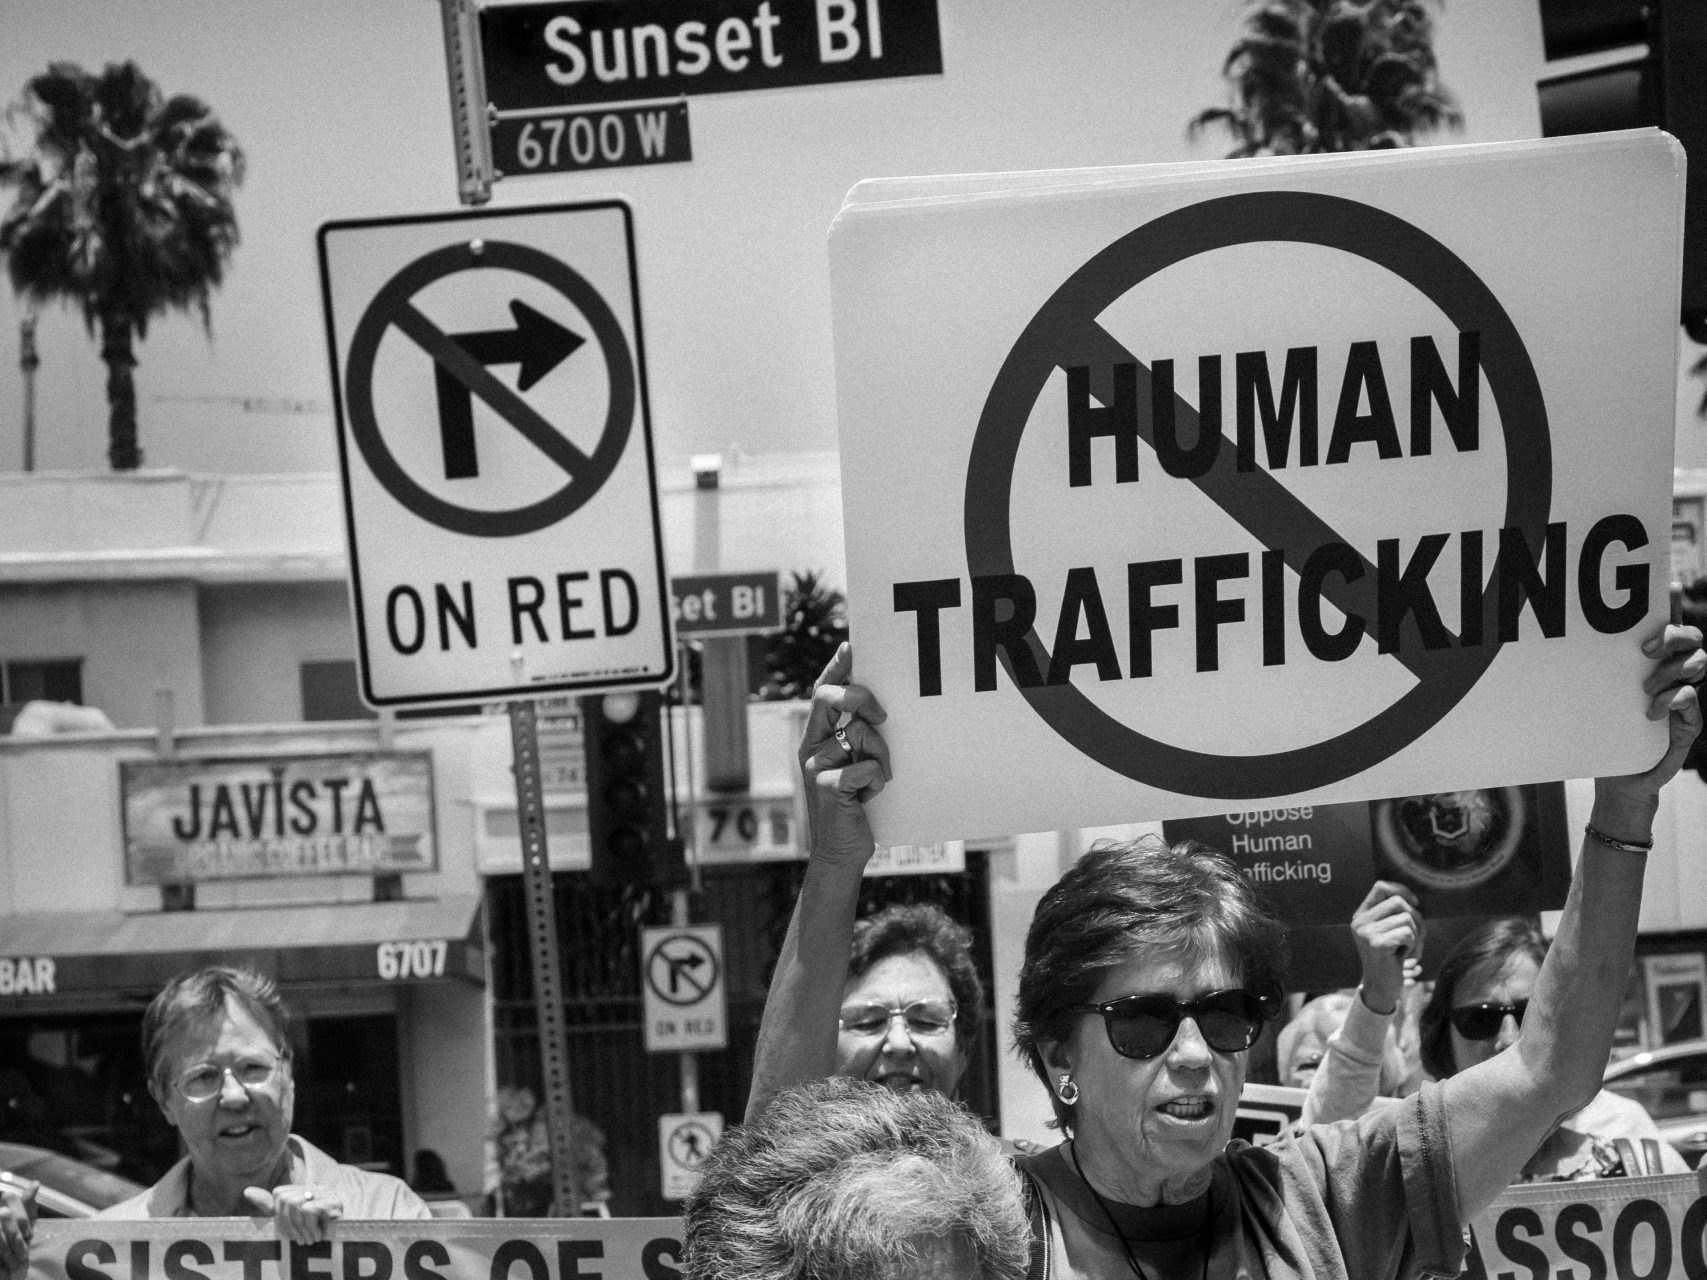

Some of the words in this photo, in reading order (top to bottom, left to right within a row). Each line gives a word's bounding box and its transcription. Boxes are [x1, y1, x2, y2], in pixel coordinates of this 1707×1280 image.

[543, 1, 784, 86] Sunset
[817, 0, 884, 64] Bl
[517, 116, 627, 169] 6700
[635, 111, 668, 159] W
[1066, 330, 1482, 488] HUMAN
[386, 580, 478, 656] ON
[508, 568, 641, 645] RED
[674, 587, 718, 622] et
[731, 585, 765, 619] Bl
[892, 513, 1651, 699] TRAFFICKING
[173, 766, 384, 841] JAVISTA
[1231, 833, 1312, 854] Human
[1243, 860, 1332, 884] afficking
[0, 958, 56, 995] BAR
[377, 941, 448, 979] 6707
